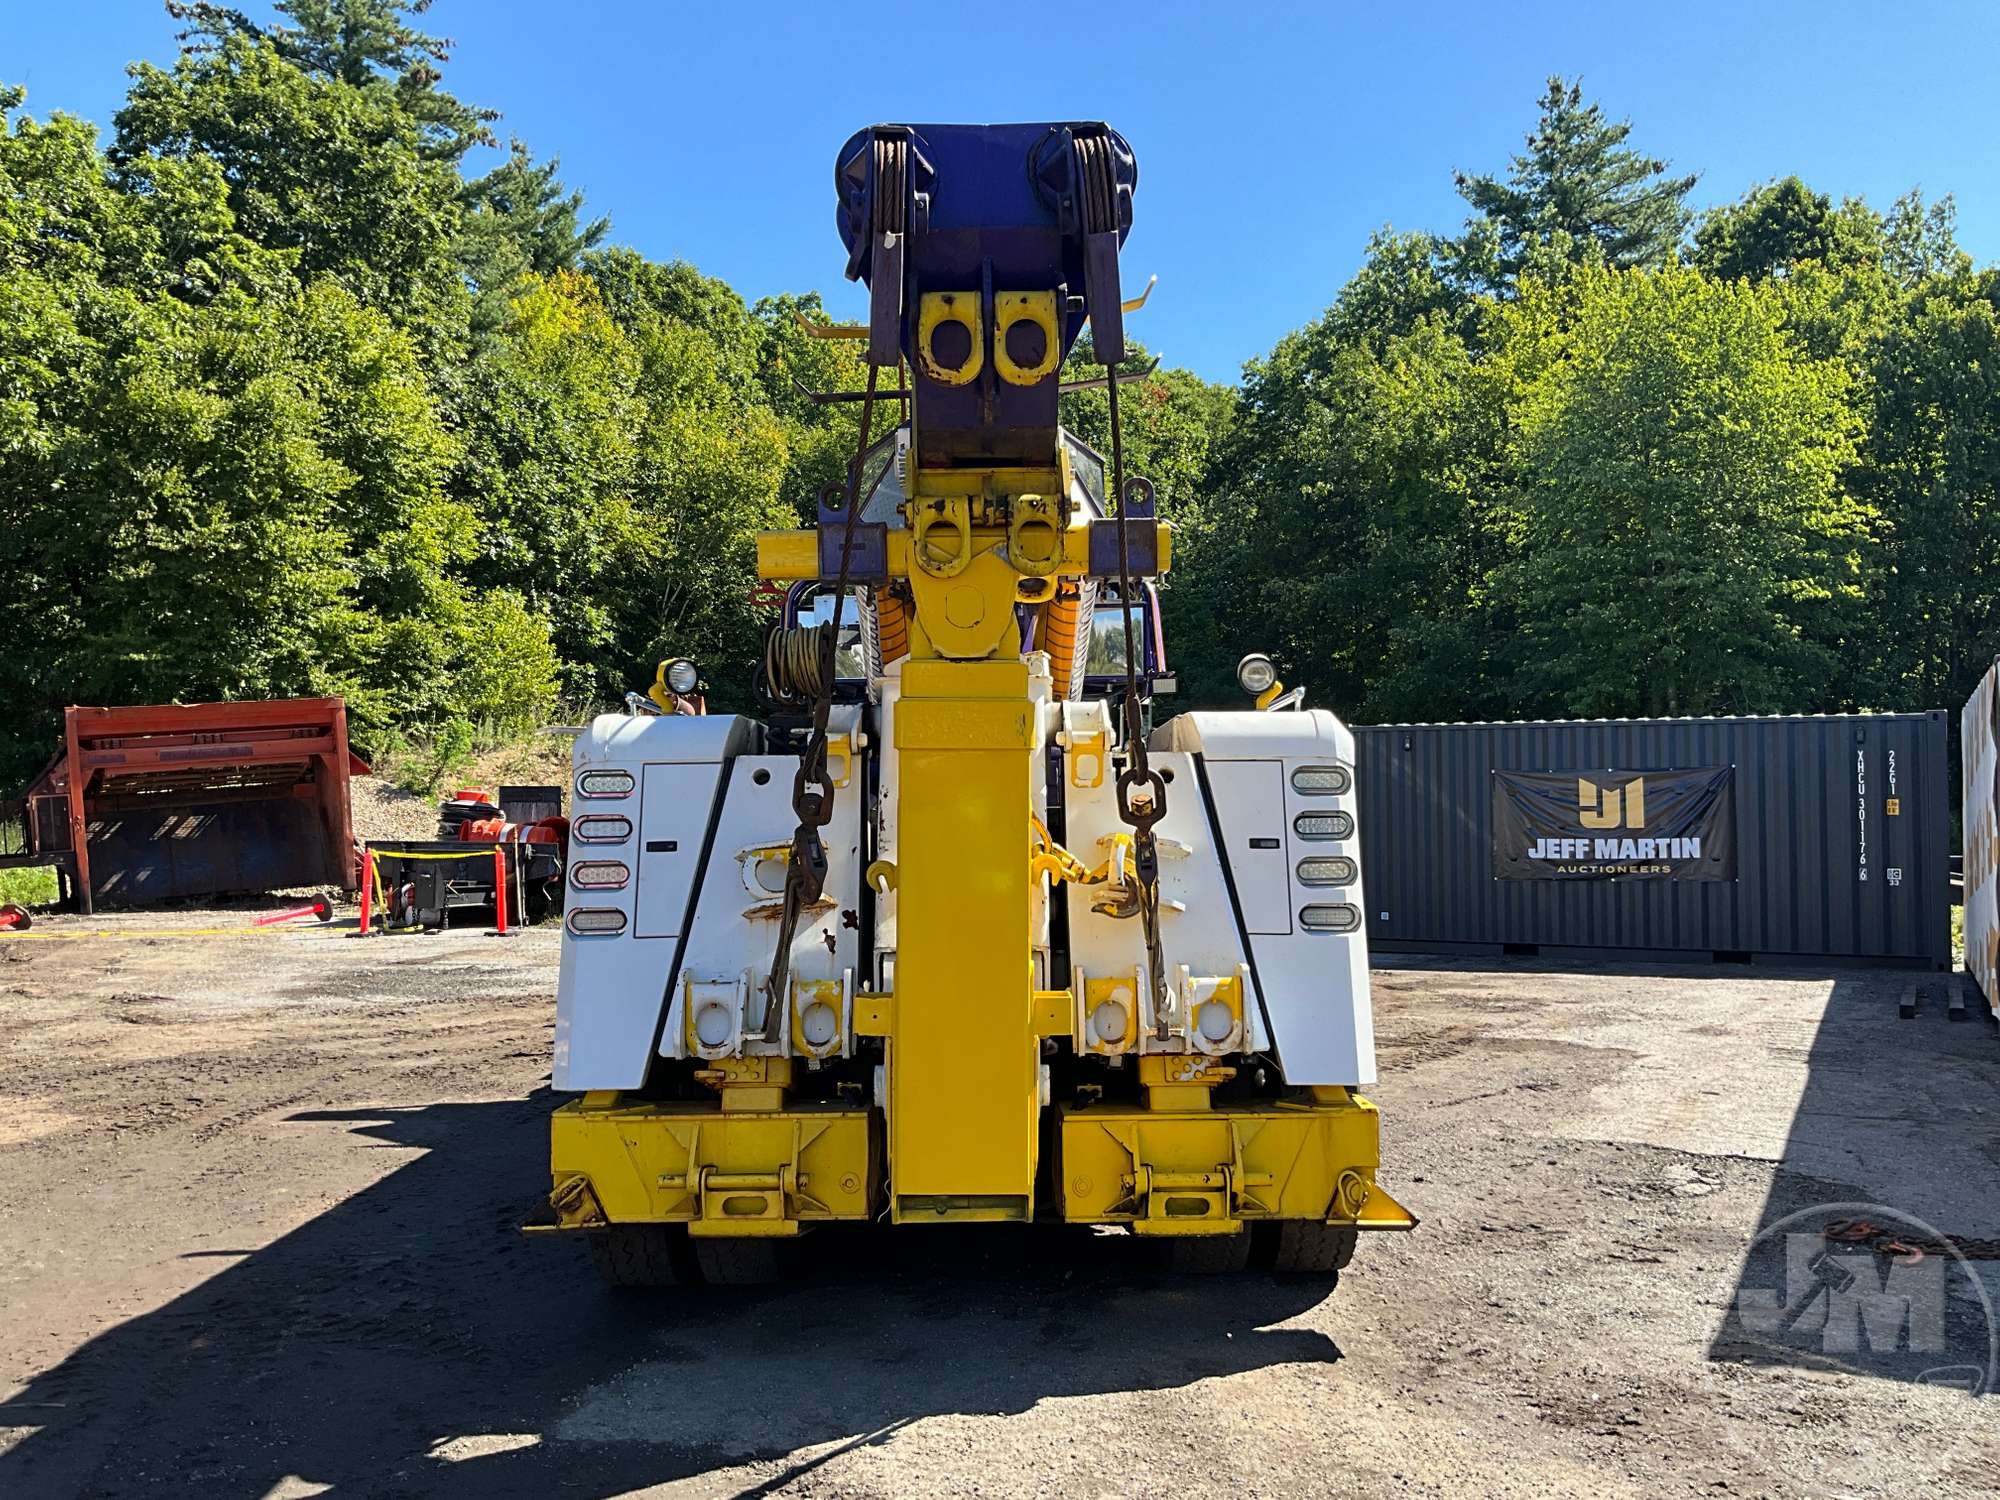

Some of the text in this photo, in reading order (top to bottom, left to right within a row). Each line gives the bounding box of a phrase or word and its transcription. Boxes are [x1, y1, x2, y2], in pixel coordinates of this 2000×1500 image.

[1888, 750, 1896, 795] 22G1
[1857, 750, 1867, 881] XHCU 301176 6
[1528, 837, 1701, 860] JEFF MARTIN
[1557, 864, 1672, 874] AUCTIONEERS
